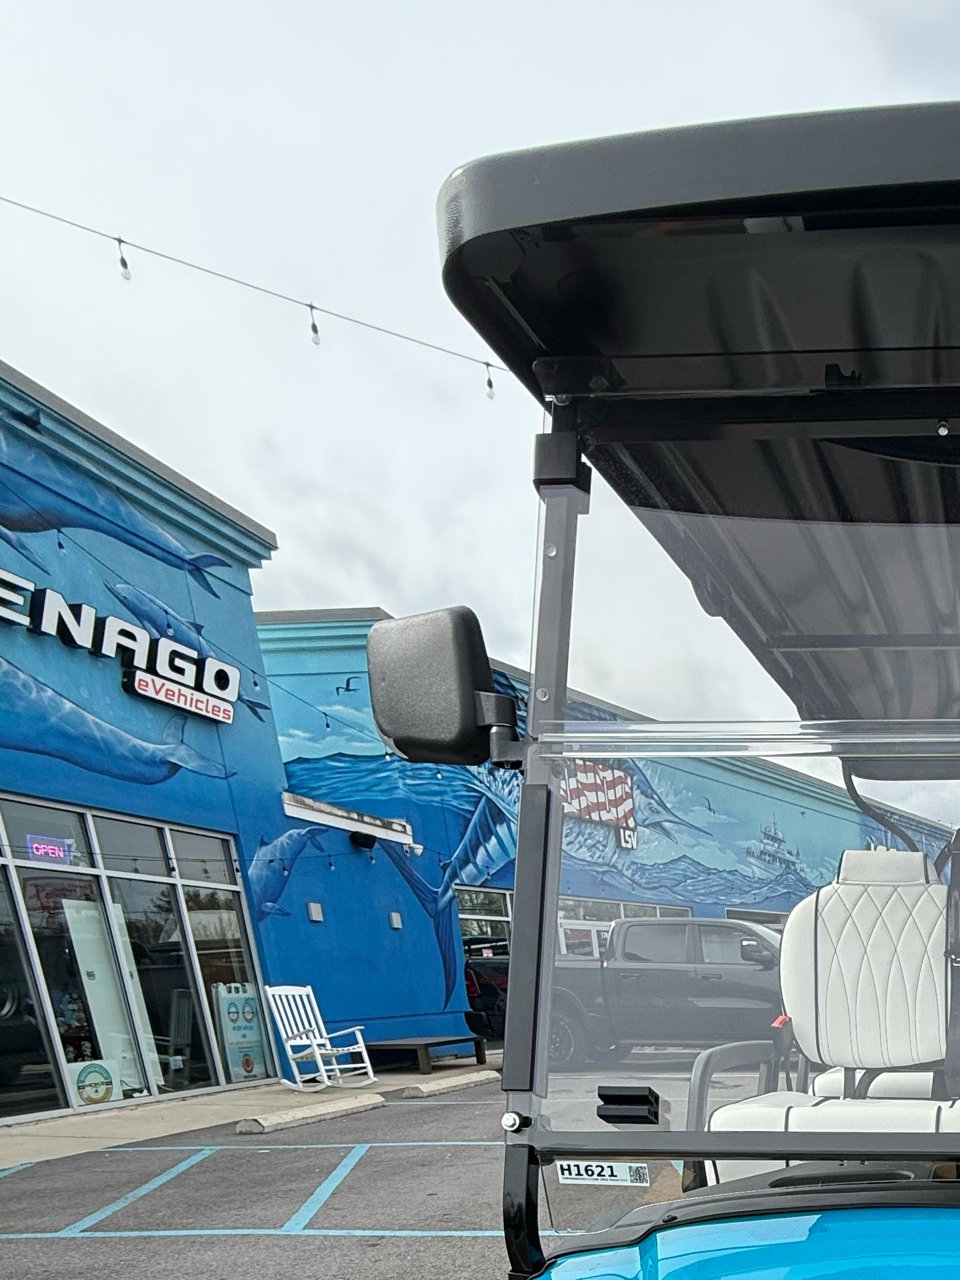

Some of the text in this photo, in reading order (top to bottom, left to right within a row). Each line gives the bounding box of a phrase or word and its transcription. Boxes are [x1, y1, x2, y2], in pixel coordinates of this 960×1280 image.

[137, 678, 232, 721] eVehicles
[619, 828, 638, 850] LSV
[32, 843, 64, 858] OPEN
[559, 1163, 618, 1178] H1621
